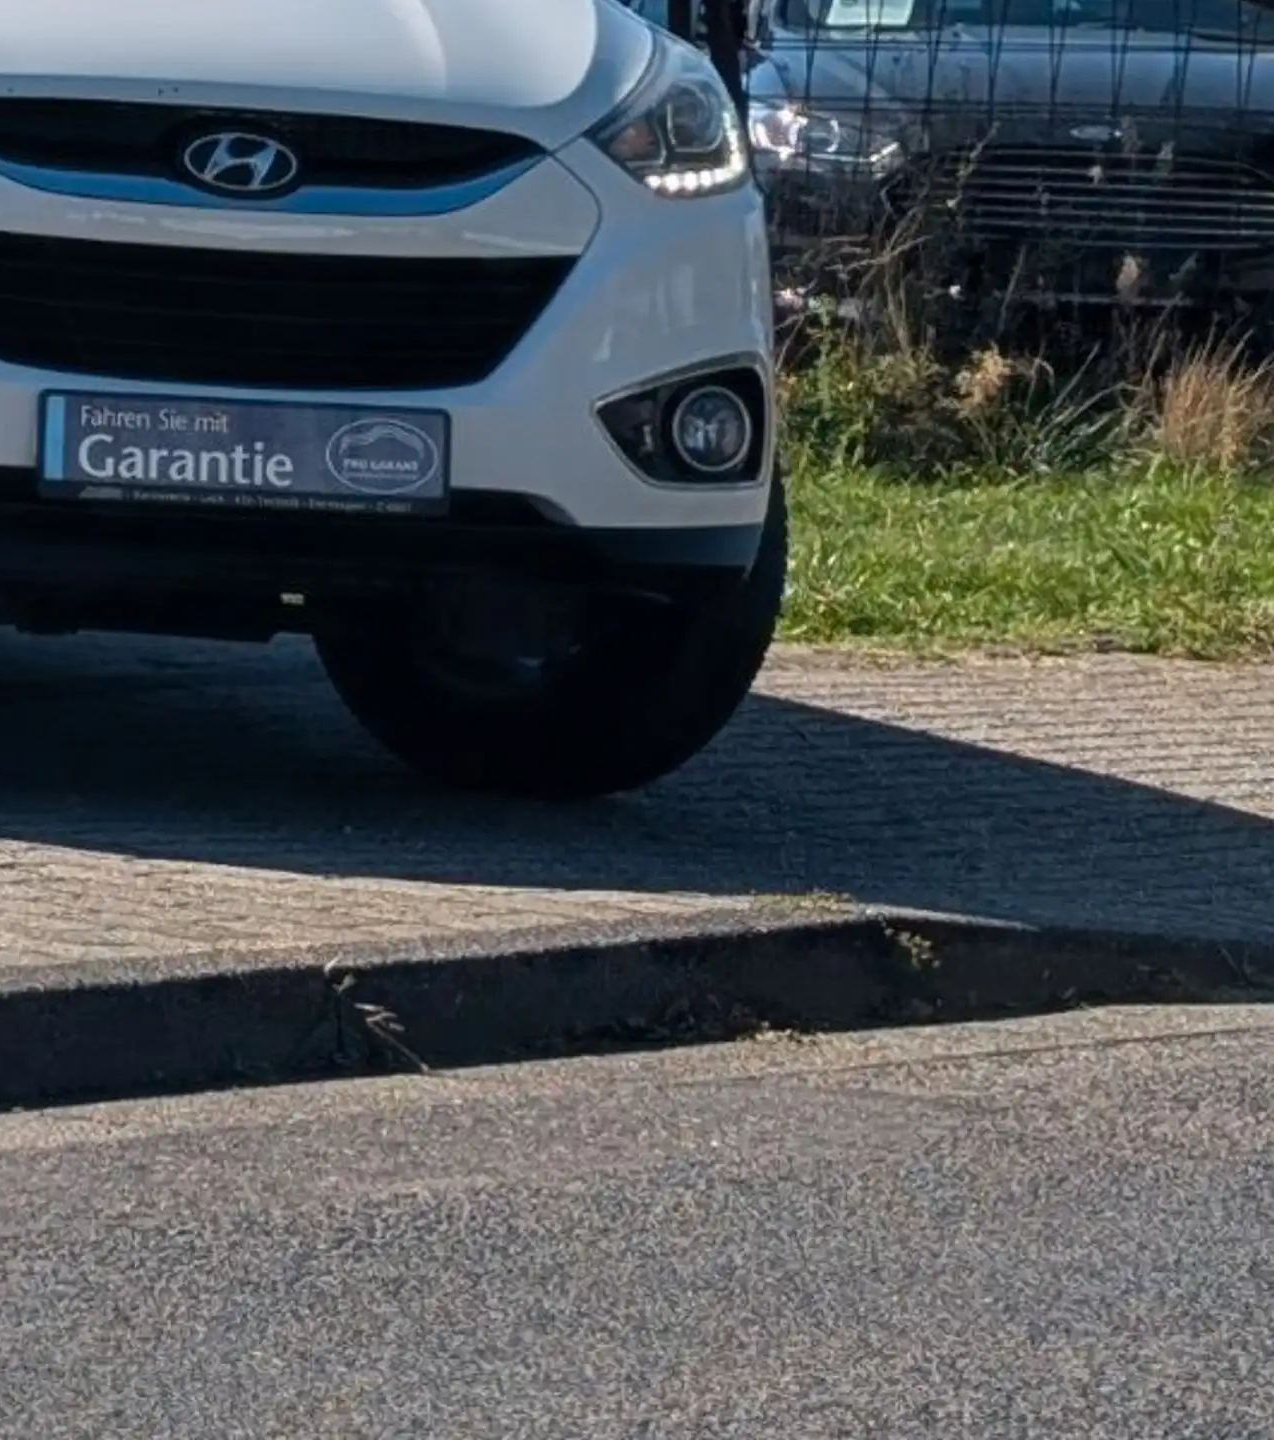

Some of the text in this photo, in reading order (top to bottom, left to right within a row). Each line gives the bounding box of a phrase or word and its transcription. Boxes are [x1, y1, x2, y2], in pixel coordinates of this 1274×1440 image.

[80, 405, 229, 434] Fahren Sie mit
[78, 433, 294, 487] Garantie
